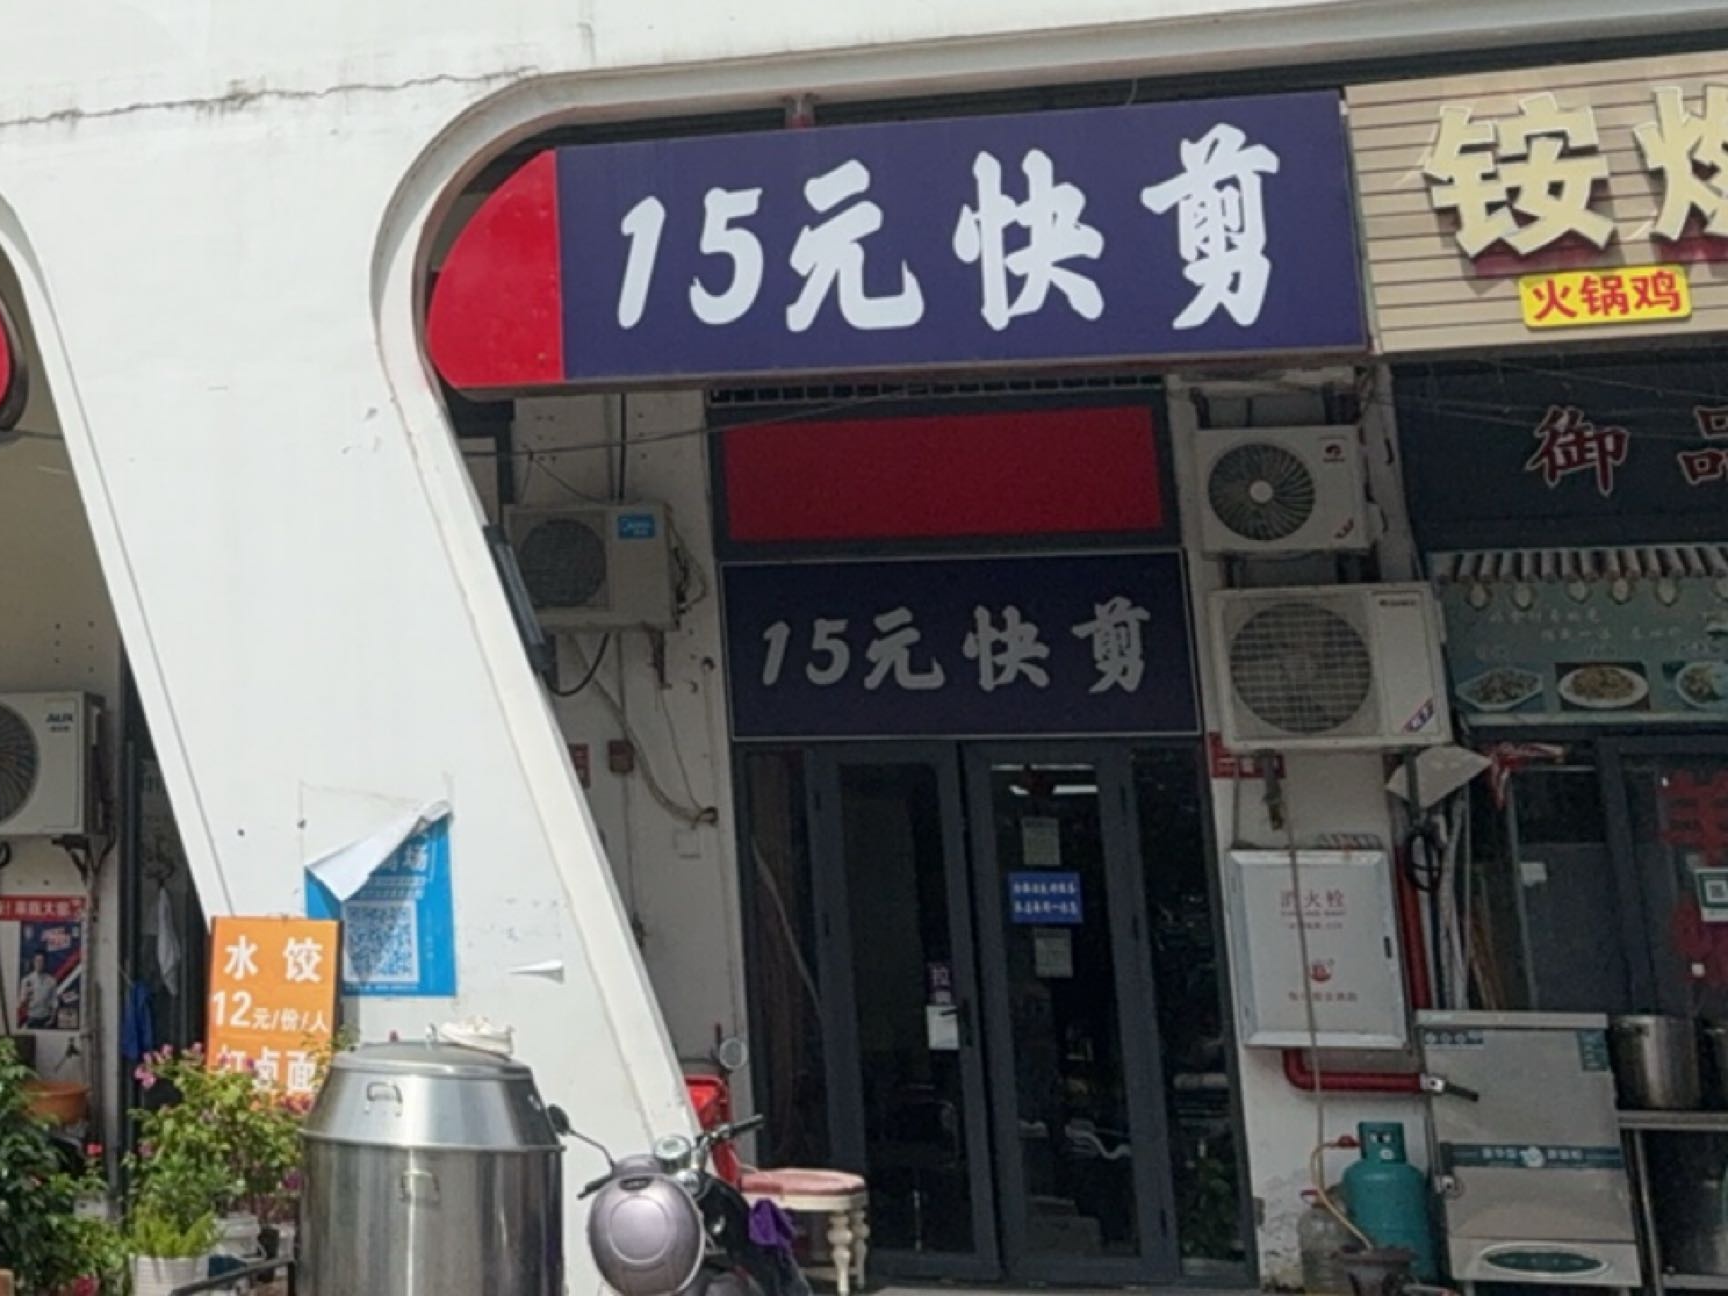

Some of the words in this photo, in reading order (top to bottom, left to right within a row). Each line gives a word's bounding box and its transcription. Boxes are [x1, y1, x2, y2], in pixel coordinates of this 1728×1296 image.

[616, 121, 1281, 332] 15元快剪
[1531, 270, 1683, 322] 火锅鸡
[761, 595, 1152, 694] 15元快剪
[223, 934, 324, 984] 水饺
[212, 990, 330, 1030] 12元/份/人
